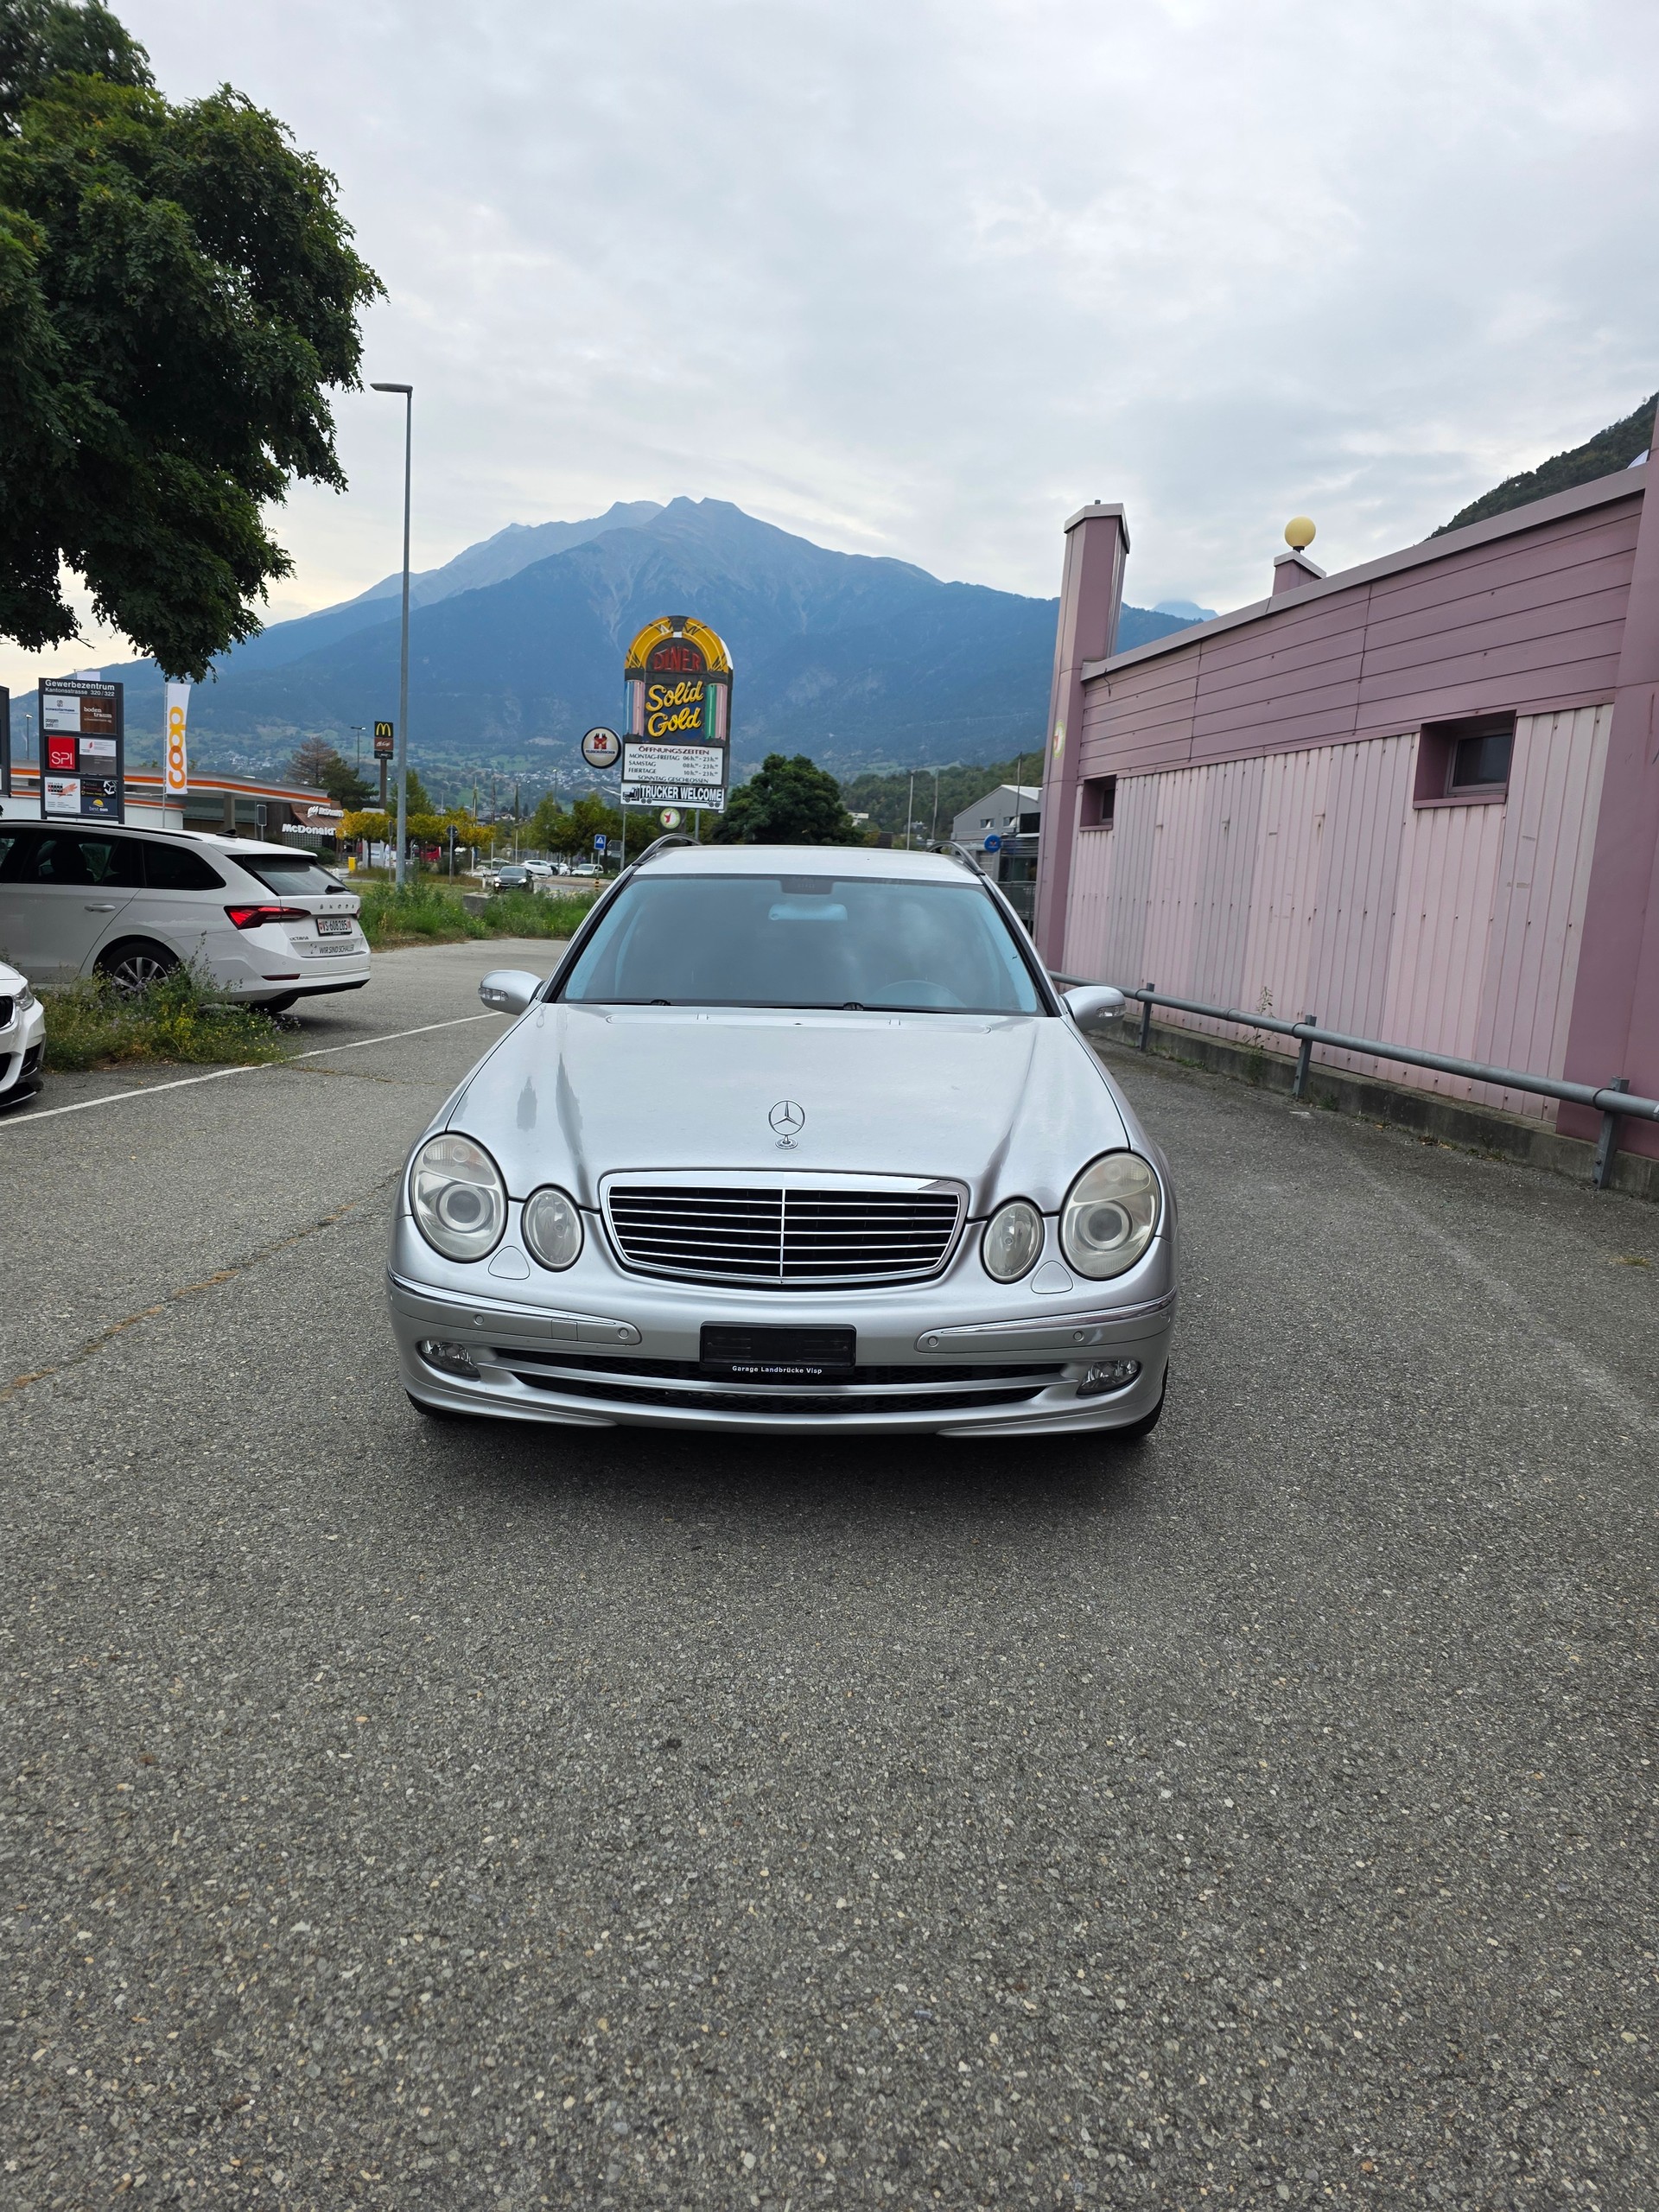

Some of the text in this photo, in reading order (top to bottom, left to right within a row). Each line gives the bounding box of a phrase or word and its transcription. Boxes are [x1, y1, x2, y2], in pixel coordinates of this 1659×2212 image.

[653, 646, 702, 671] DINER
[45, 679, 115, 690] Gewerbezentrum
[645, 680, 704, 711] Solid
[647, 707, 701, 737] Gold
[168, 706, 186, 789] coop
[639, 746, 709, 755] ÖFFNUNGSZEITEN
[51, 751, 73, 765] SPI
[640, 785, 722, 802] TRUCKER WELCOME
[282, 823, 337, 836] McDonald'
